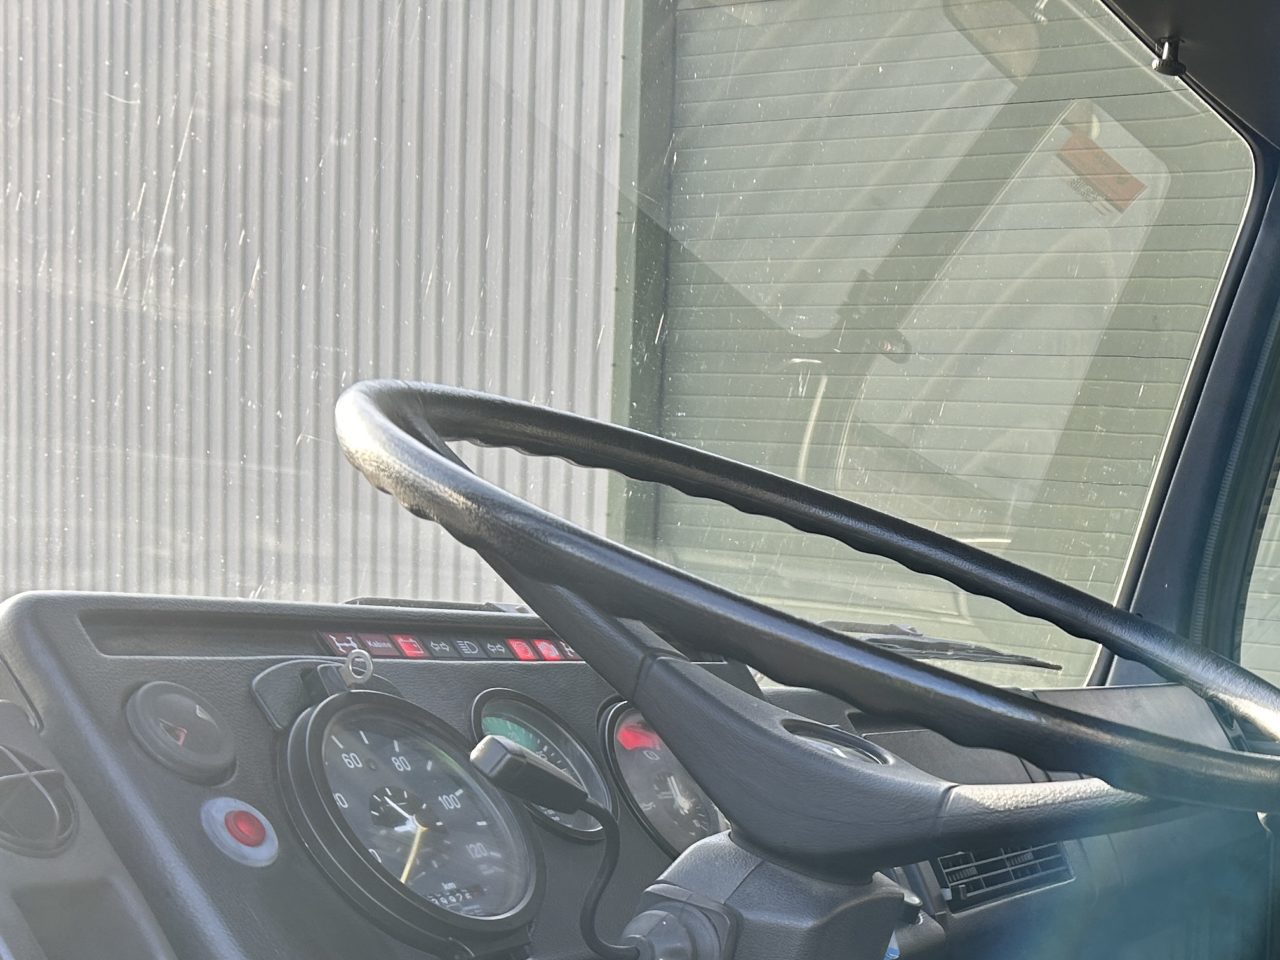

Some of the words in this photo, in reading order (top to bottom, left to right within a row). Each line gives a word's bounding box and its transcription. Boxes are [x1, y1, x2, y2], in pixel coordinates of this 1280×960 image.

[341, 753, 363, 769] 60
[391, 756, 412, 771] 80
[438, 794, 462, 810] 100
[466, 843, 488, 859] 120
